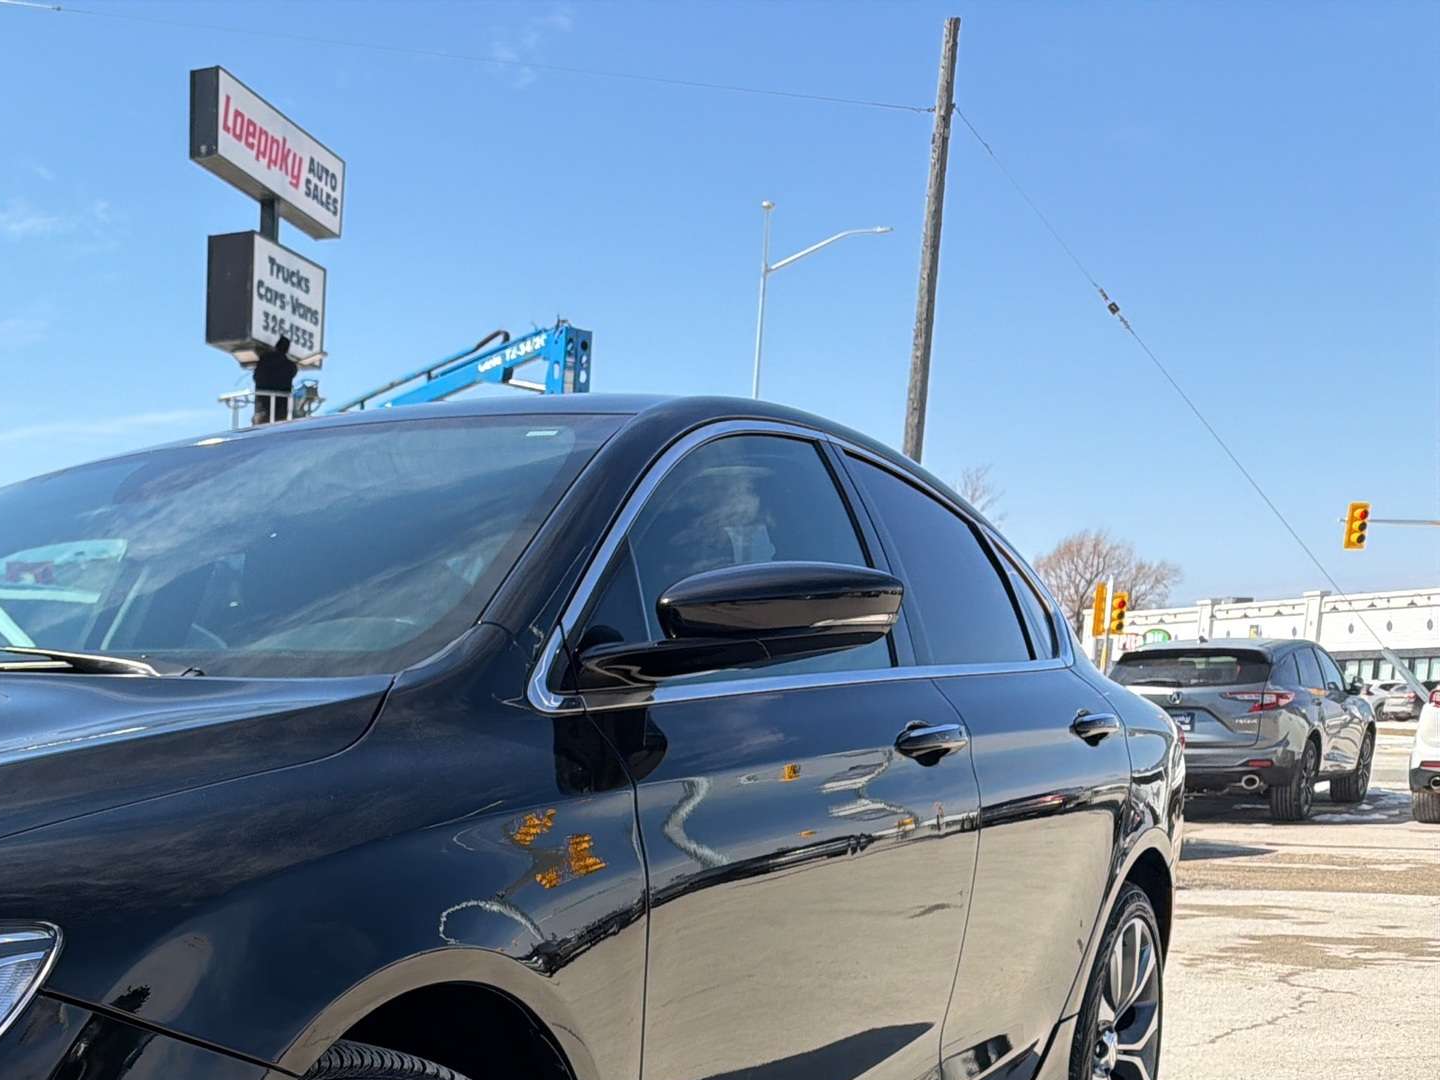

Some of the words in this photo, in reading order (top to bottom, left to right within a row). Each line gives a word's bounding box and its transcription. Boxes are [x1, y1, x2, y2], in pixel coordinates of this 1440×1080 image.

[222, 94, 303, 190] Loeppky
[308, 156, 338, 192] AUTO
[305, 178, 338, 216] SALES
[268, 255, 311, 294] Trucks
